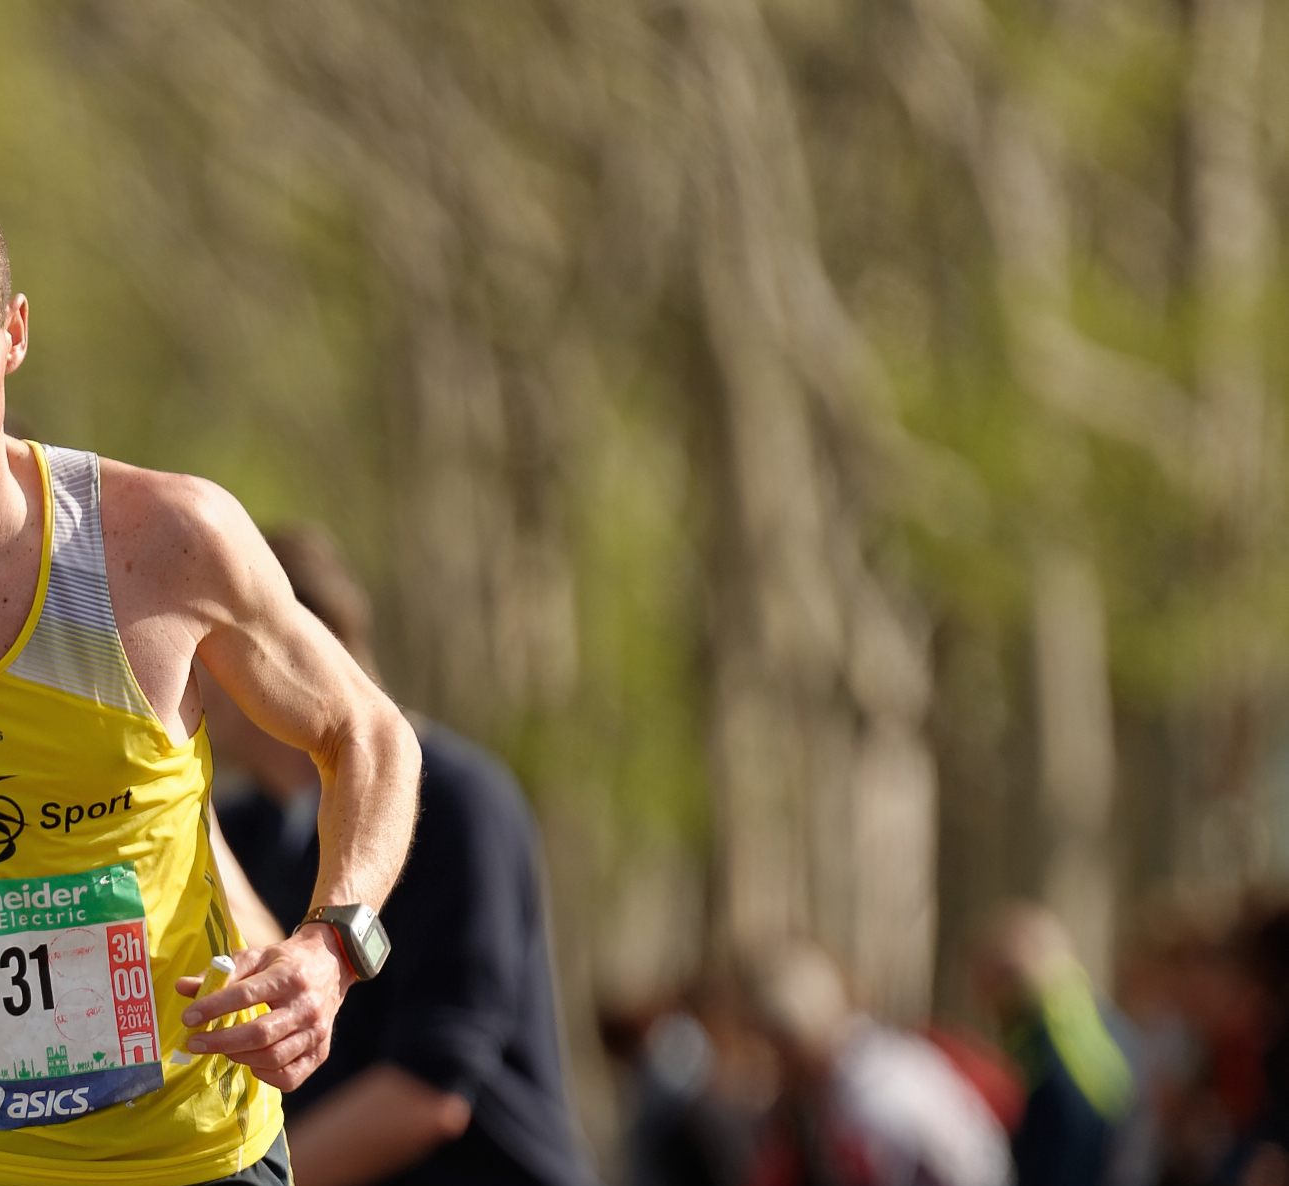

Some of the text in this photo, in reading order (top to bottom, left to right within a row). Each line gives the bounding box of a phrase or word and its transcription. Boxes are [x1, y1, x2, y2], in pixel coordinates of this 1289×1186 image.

[40, 787, 133, 833] Sport
[111, 933, 142, 963] 3h
[113, 966, 147, 1001] 00
[117, 1003, 150, 1014] 6 Avril
[119, 1014, 151, 1030] 2014
